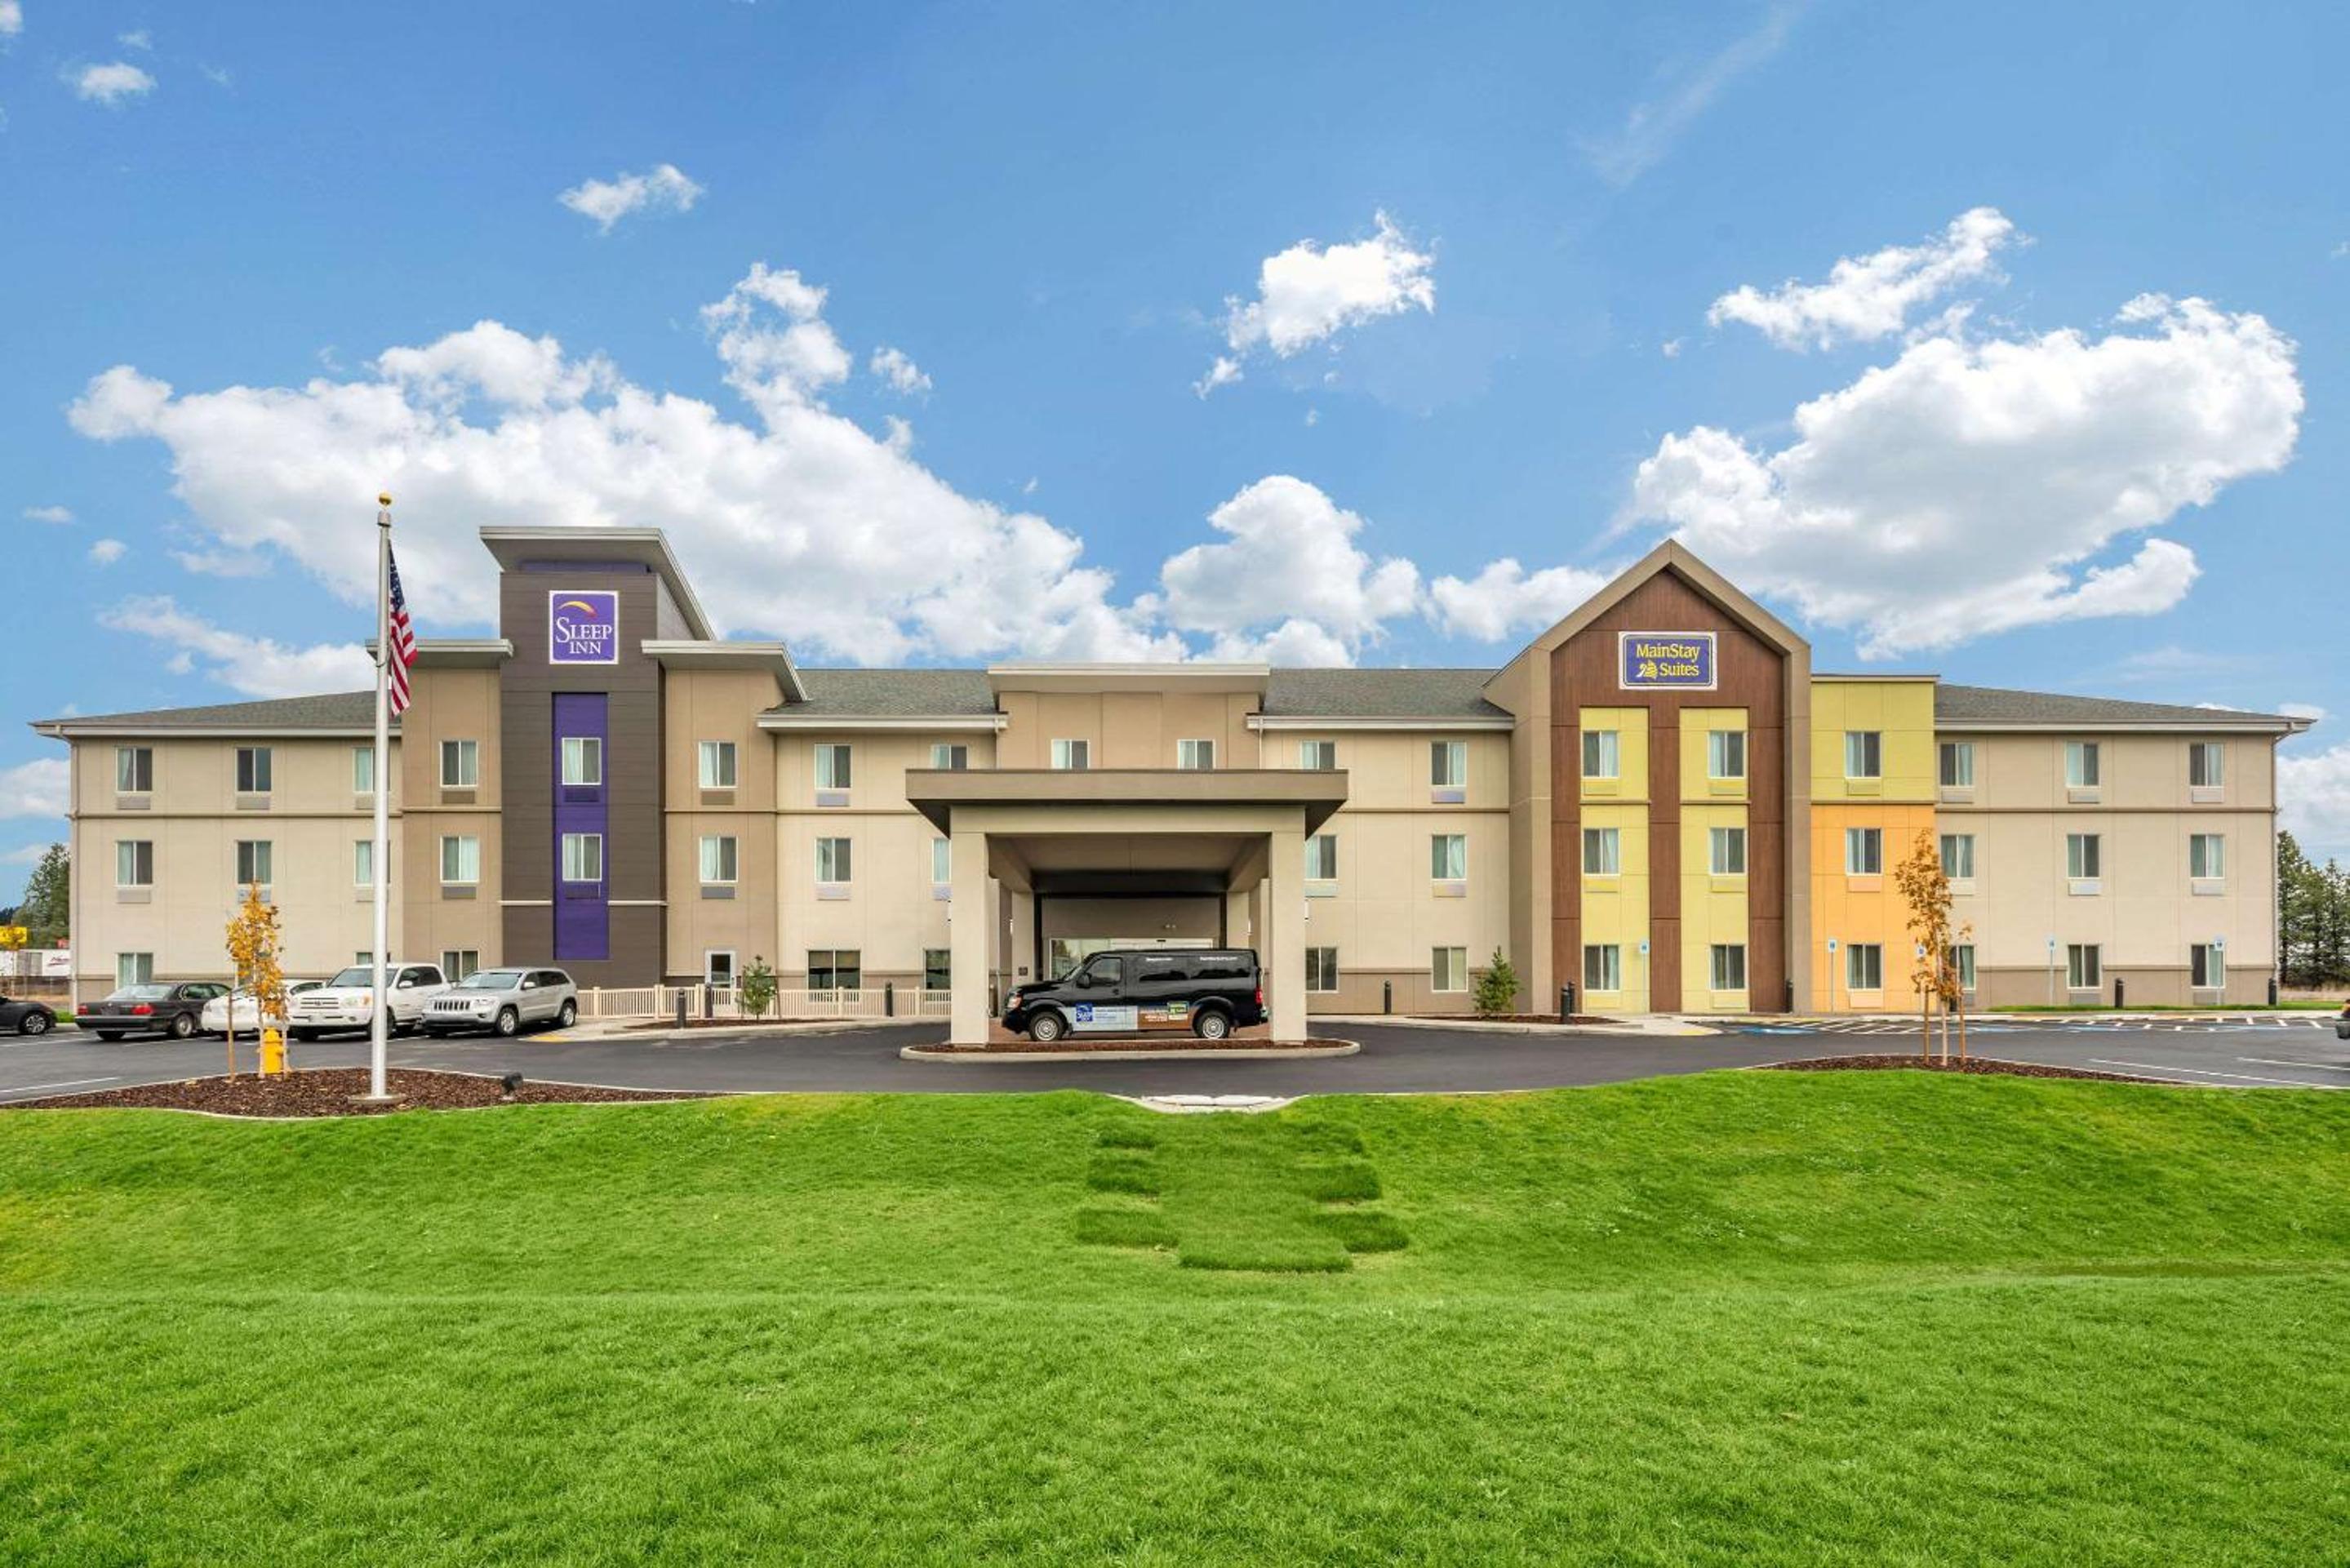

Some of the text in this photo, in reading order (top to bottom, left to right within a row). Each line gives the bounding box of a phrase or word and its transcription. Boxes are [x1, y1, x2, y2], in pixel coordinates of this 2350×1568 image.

[556, 616, 612, 643] SLEEP
[569, 641, 602, 654] INN
[1637, 643, 1700, 662] MainStay
[1659, 662, 1699, 677] Suites
